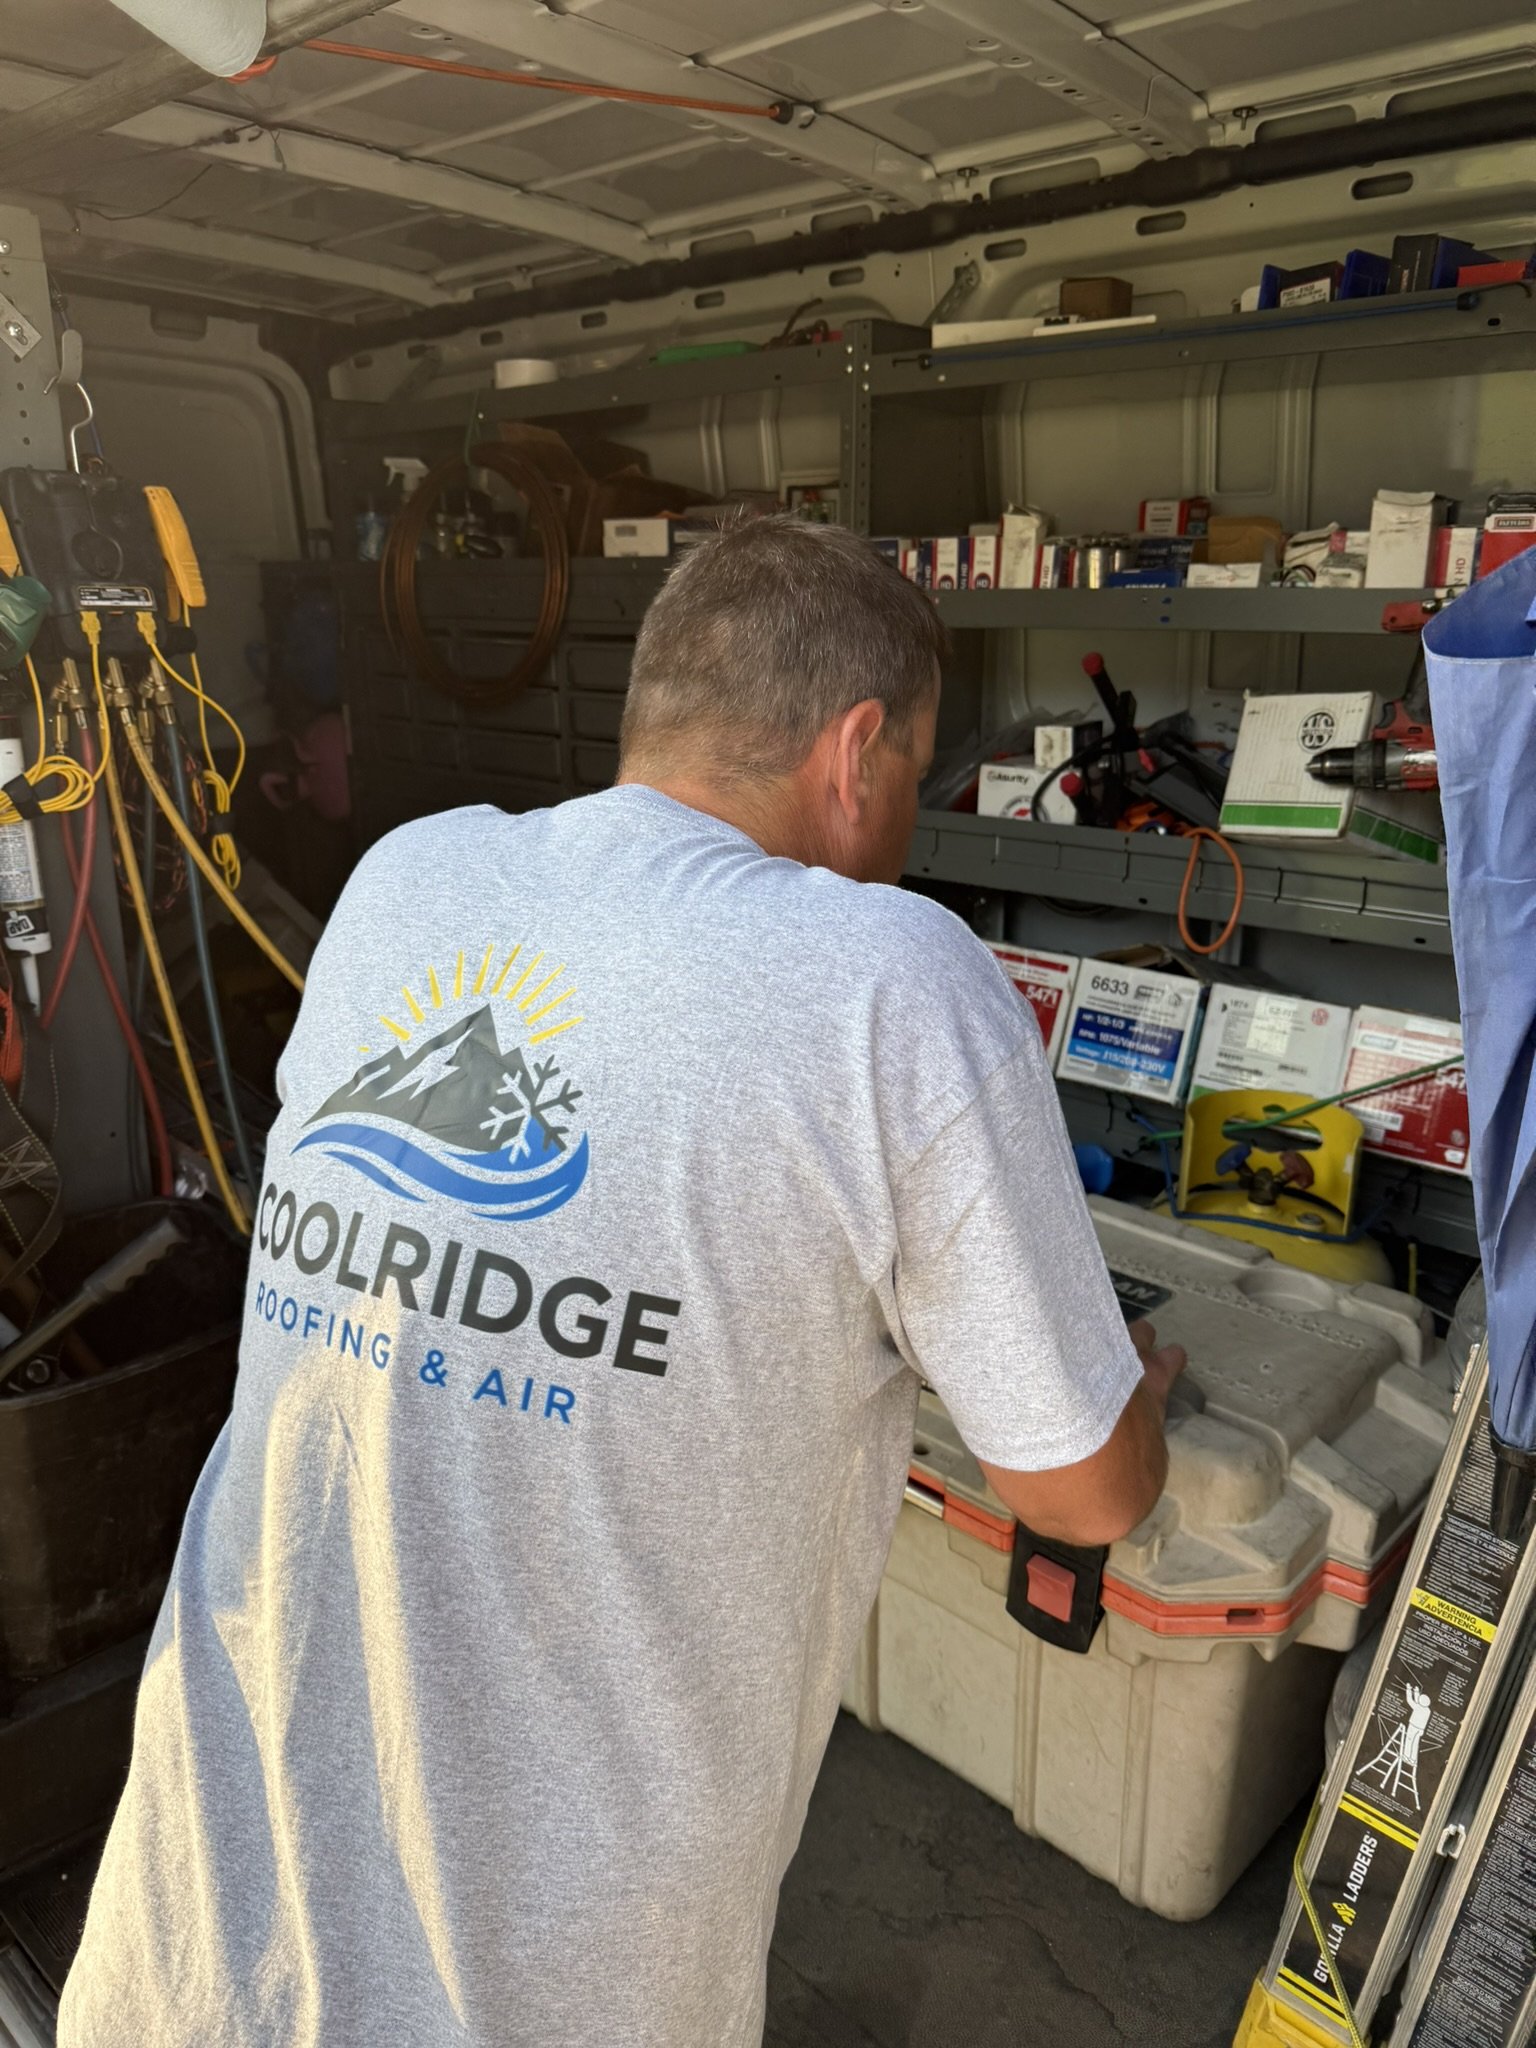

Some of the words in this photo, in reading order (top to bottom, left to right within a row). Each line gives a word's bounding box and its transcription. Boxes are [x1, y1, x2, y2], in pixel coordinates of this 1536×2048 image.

[1455, 558, 1466, 575] HD
[1026, 984, 1058, 1004] 5471
[1091, 976, 1129, 996] 6633
[1436, 1068, 1466, 1089] 547
[259, 1182, 682, 1377] COOLRIDGE
[256, 1280, 392, 1369] ROOFING
[419, 1349, 449, 1388] &
[472, 1368, 576, 1425] AIR
[1425, 1603, 1483, 1636] ADVERTENCIA
[1437, 1600, 1477, 1625] WARNING
[1415, 1611, 1441, 1626] PROPER
[1468, 1636, 1482, 1647] USE
[1418, 1627, 1432, 1637] USO
[1431, 1634, 1469, 1656] ADECUADOS
[1498, 1825, 1515, 1838] MODO
[1343, 1835, 1378, 1902] LADDERS
